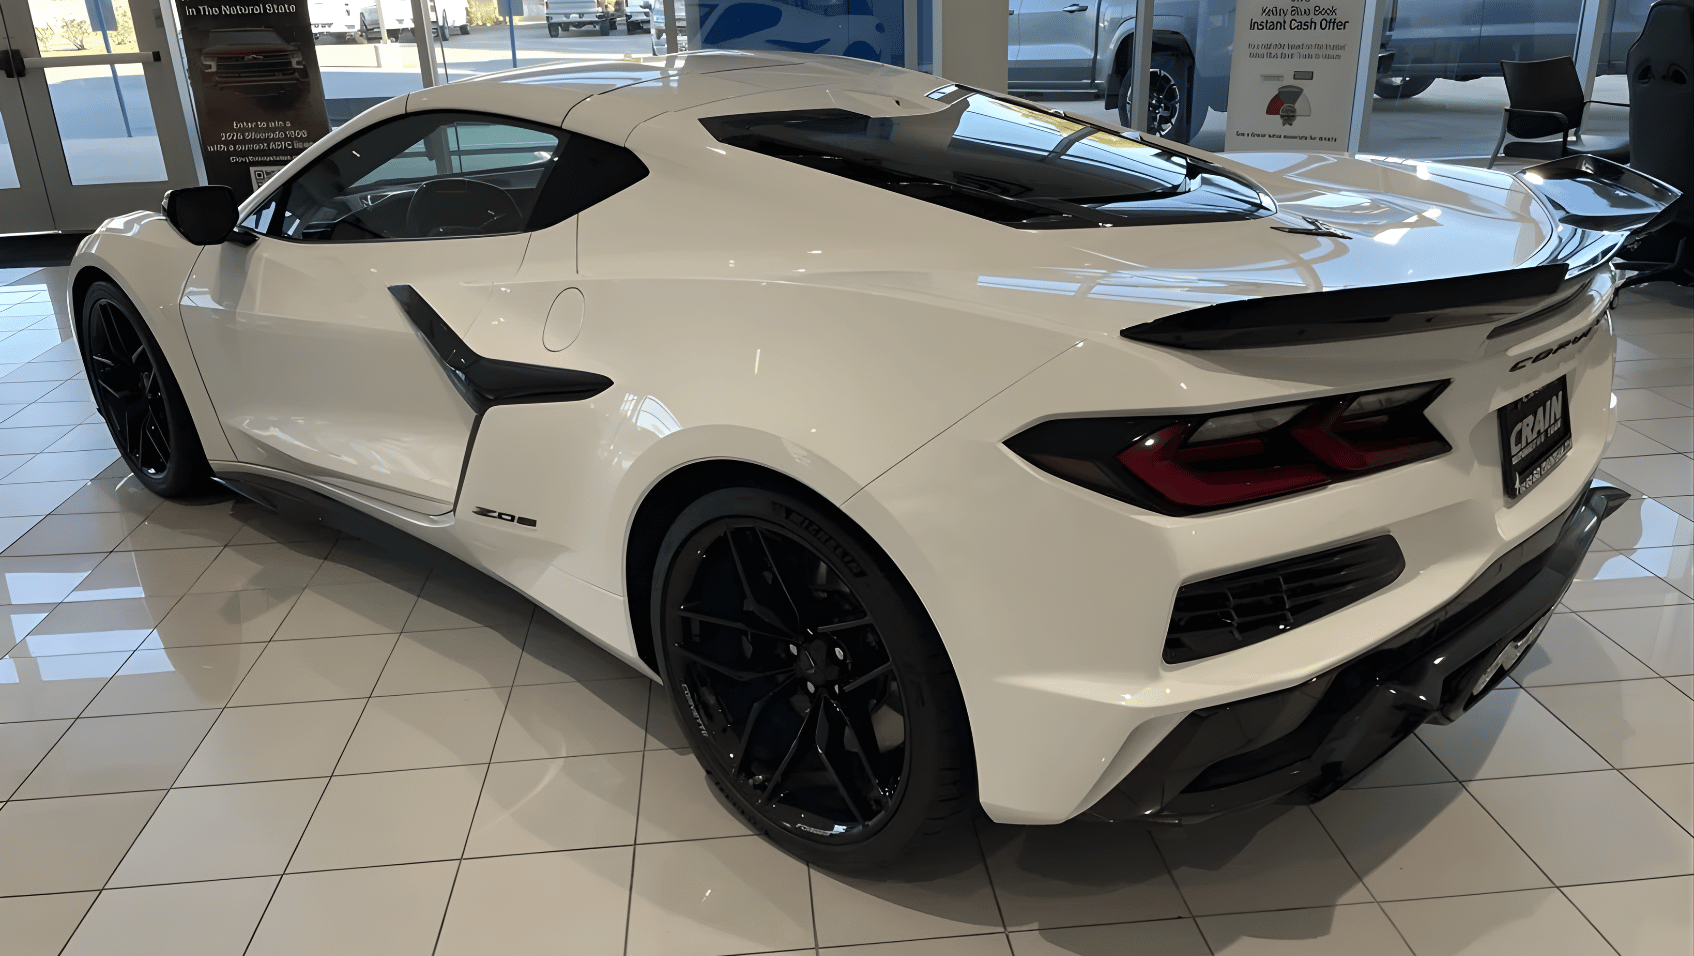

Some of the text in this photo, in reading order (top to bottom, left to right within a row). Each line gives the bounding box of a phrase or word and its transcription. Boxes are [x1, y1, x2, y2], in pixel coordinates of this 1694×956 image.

[185, 5, 196, 15] In
[221, 4, 263, 15] Natural
[1313, 5, 1338, 16] Book
[1249, 18, 1350, 31] Instant Cash Offer
[1510, 391, 1563, 456] CRAIN
